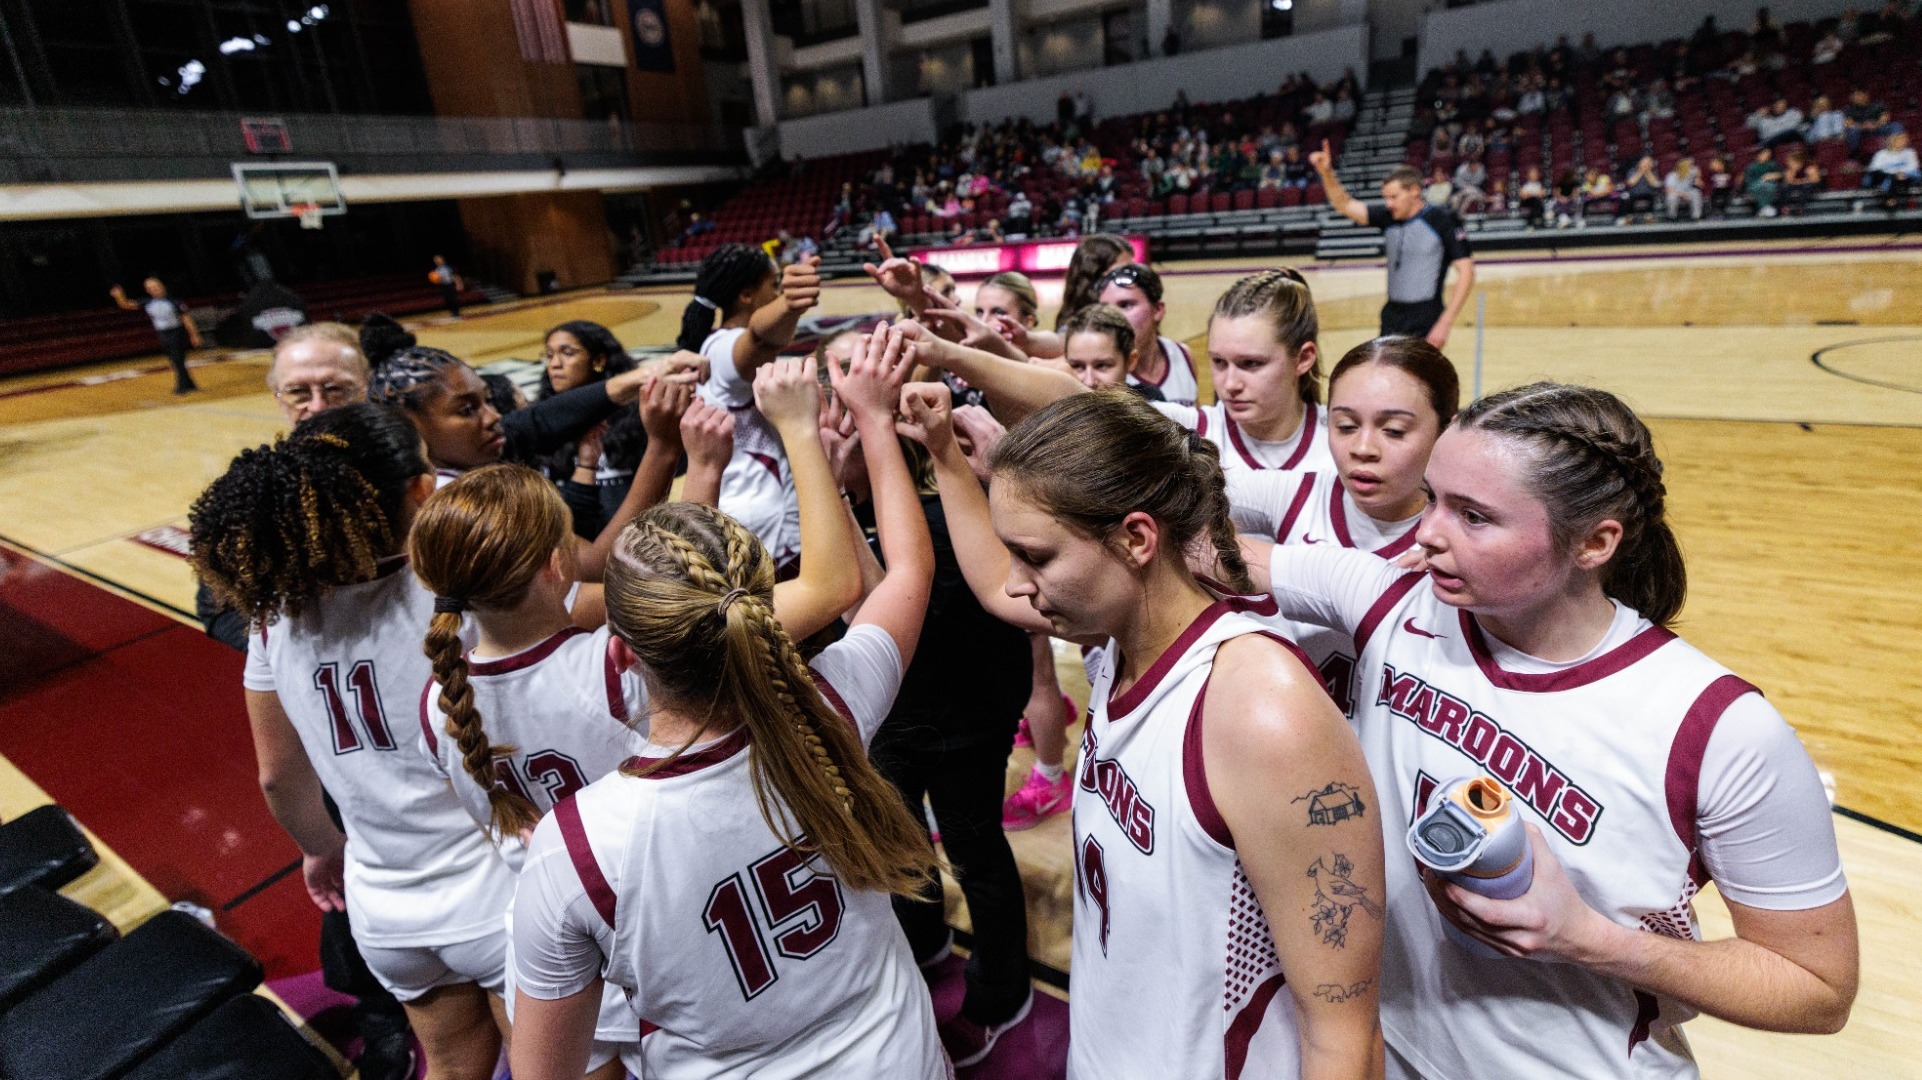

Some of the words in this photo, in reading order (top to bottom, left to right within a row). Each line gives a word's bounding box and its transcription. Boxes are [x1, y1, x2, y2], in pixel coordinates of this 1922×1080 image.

[313, 659, 398, 756] 11
[1376, 662, 1605, 846] MAROONS
[701, 832, 846, 1003] 15
